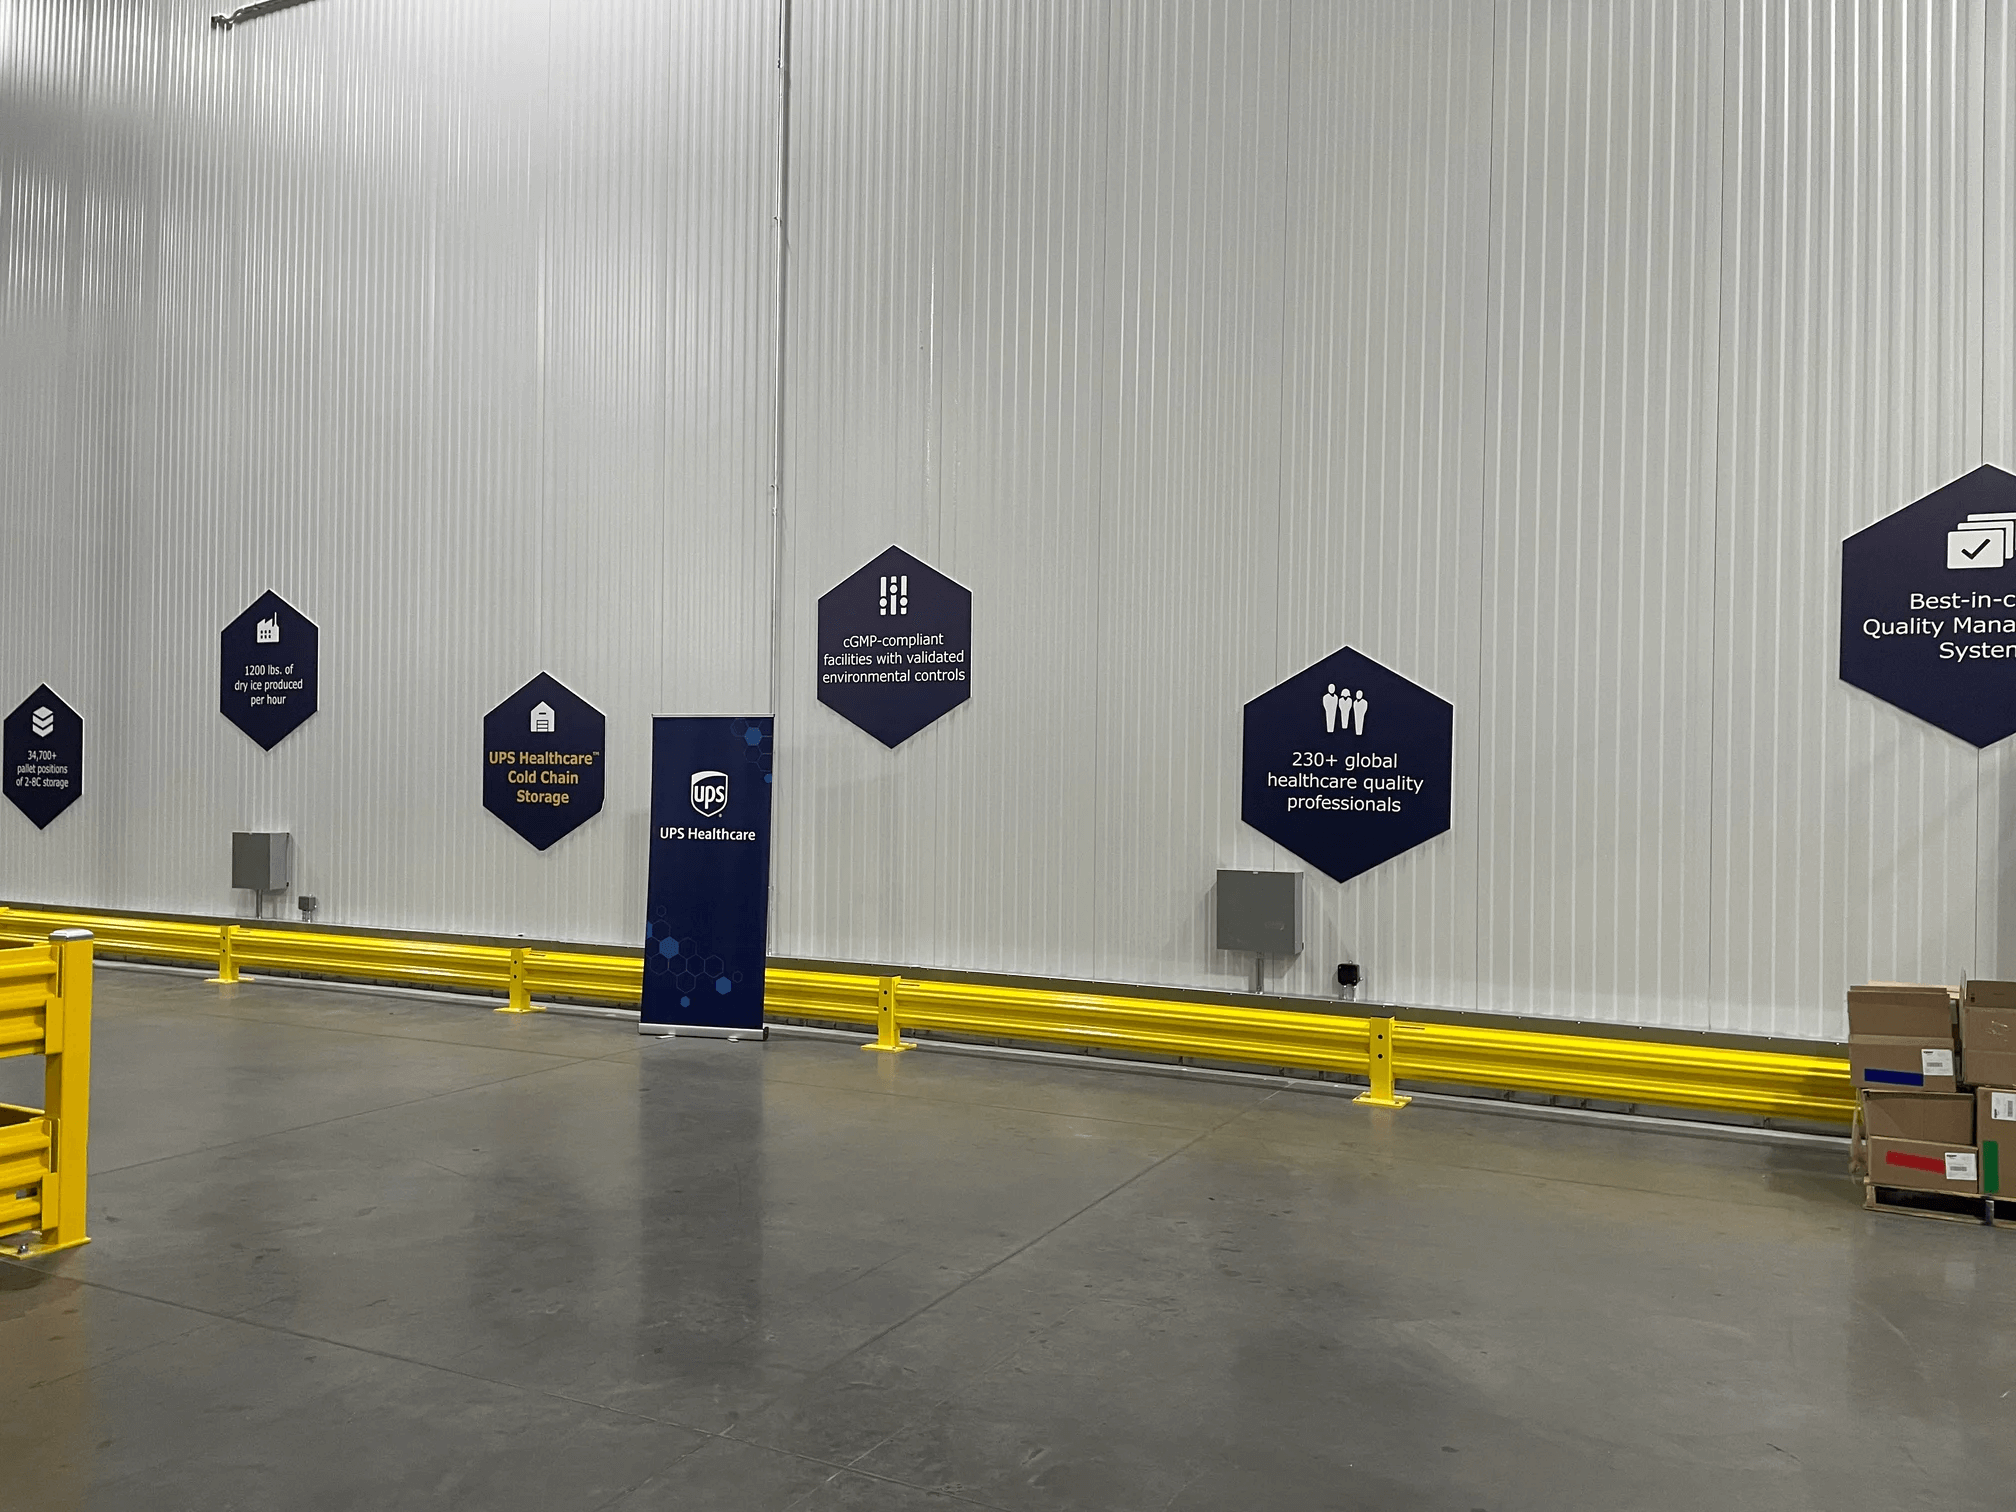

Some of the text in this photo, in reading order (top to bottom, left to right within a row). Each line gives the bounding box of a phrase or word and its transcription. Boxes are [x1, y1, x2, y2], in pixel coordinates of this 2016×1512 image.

[1911, 592, 2016, 609] Best-in-c
[1864, 617, 2016, 638] Quality Mana
[844, 633, 943, 648] cGMP-compliant
[824, 650, 963, 665] facilities with validated
[245, 664, 293, 675] 1200 lbs. of
[823, 668, 965, 683] environmental controls
[235, 679, 302, 692] dry ice produced
[251, 694, 286, 706] per hour
[28, 751, 56, 761] 34,700+
[490, 752, 515, 764] UPS
[1293, 752, 1397, 770] 230+ global
[17, 764, 67, 775] pallet positions
[508, 770, 578, 784] Cold Chain
[16, 777, 68, 789] of 2-8C storage
[1268, 772, 1423, 794] healthcare quality
[517, 790, 569, 806] Storage
[695, 785, 724, 809] ups
[1288, 795, 1400, 812] professionals
[661, 827, 755, 840] UPS Healthcare
